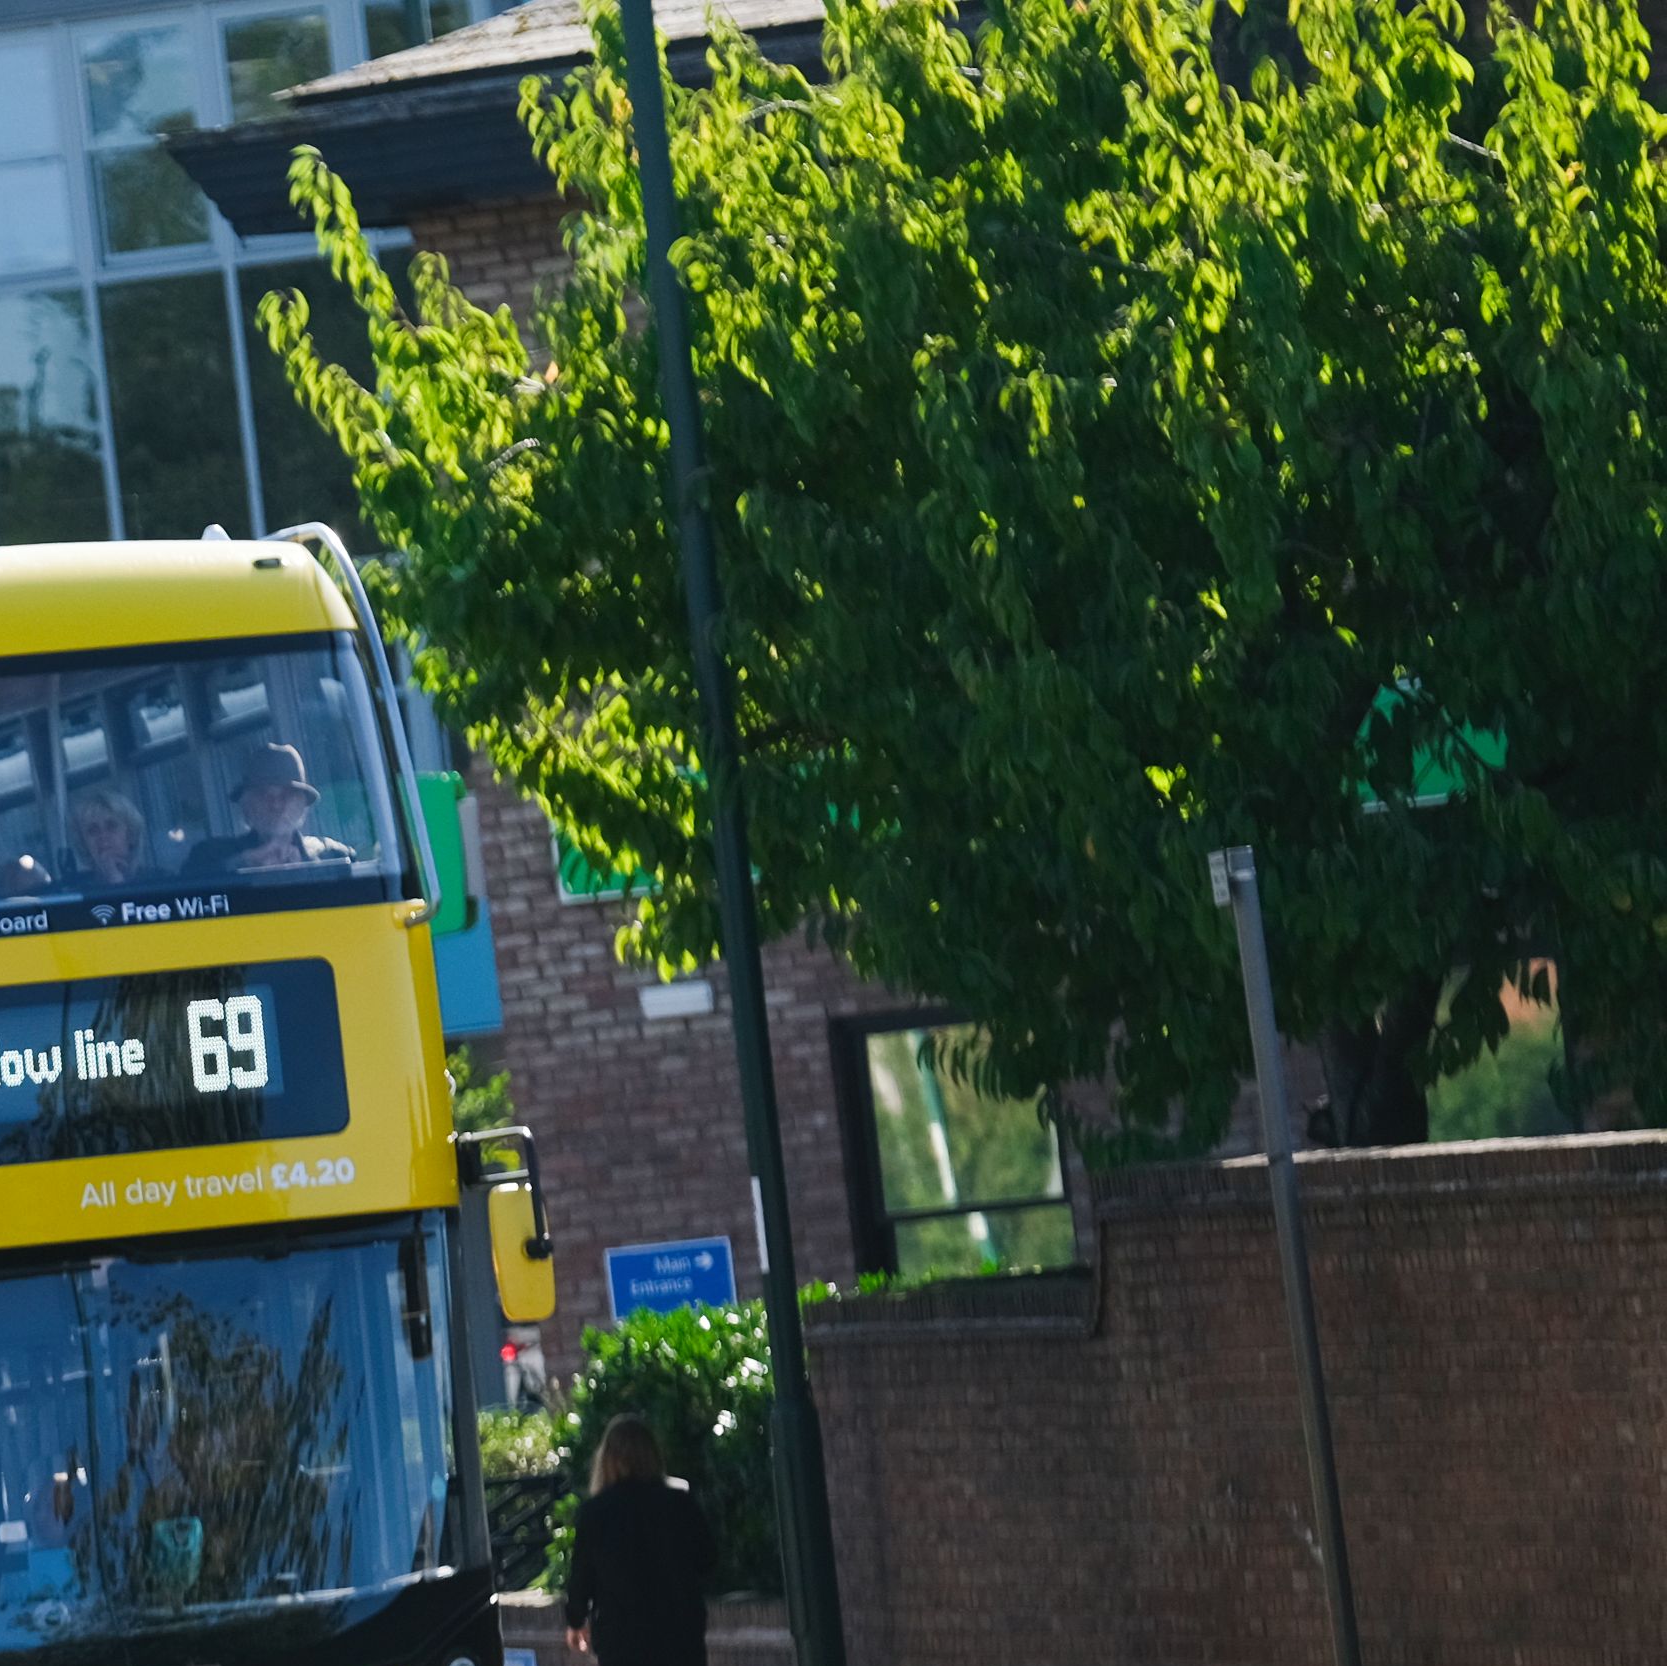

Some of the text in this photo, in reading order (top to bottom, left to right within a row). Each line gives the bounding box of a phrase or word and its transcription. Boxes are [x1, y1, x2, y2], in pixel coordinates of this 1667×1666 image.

[121, 893, 230, 924] Free Wi-Fi
[73, 1028, 146, 1082] line
[186, 994, 269, 1094] 69
[80, 1156, 357, 1210] All day travel £4.20
[653, 1254, 692, 1275] Main
[629, 1275, 694, 1297] Entrance
